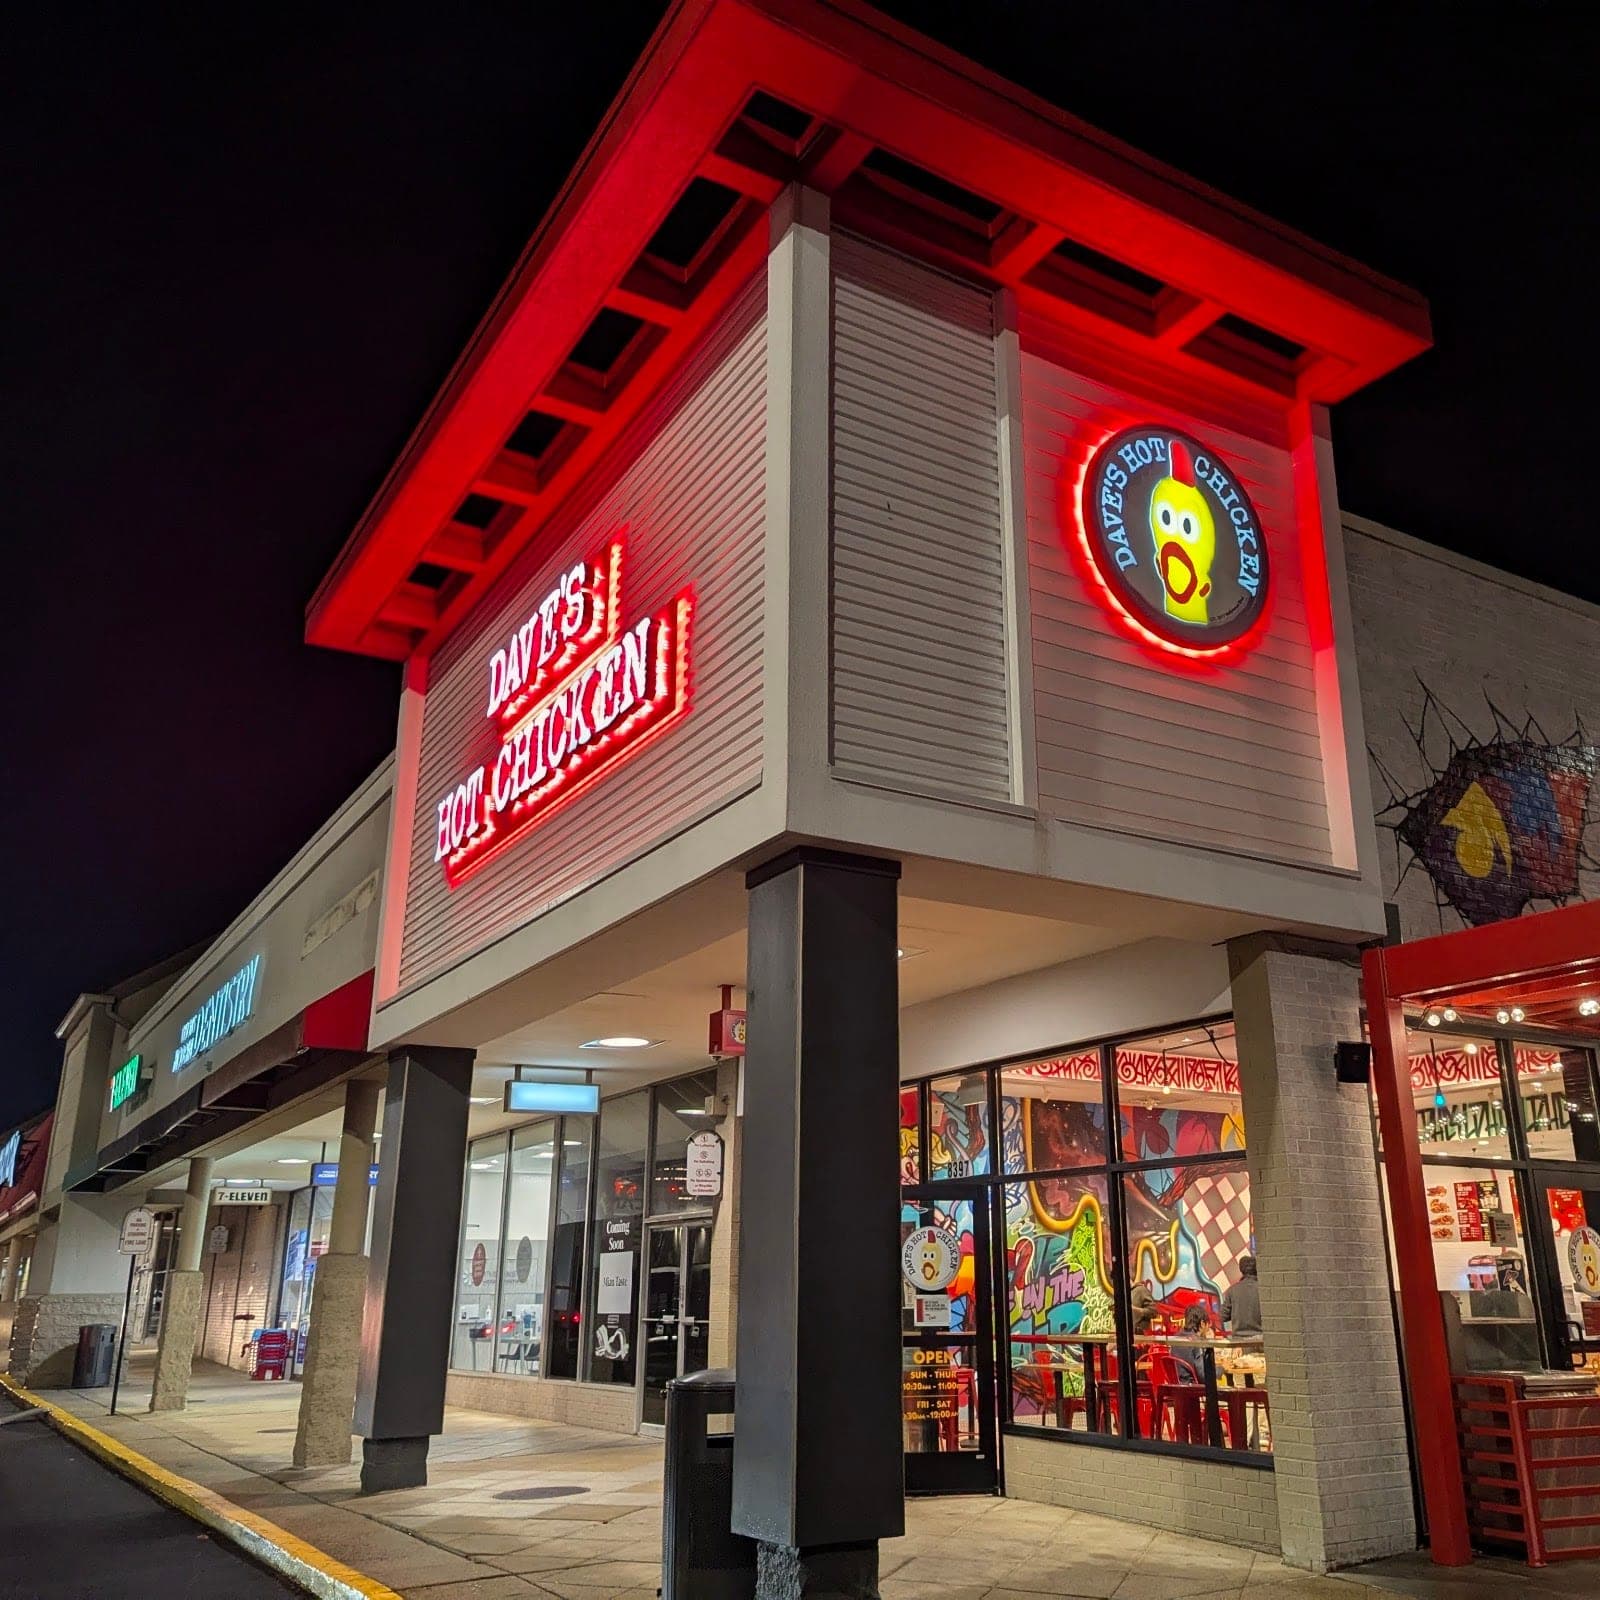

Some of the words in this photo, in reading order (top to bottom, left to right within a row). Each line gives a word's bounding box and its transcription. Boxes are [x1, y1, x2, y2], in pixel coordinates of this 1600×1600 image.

[1117, 437, 1166, 473] HOT
[1101, 463, 1137, 571] DAVE'S
[1194, 456, 1260, 597] CHICKEN
[487, 562, 585, 717] DAVE'S
[434, 766, 485, 862] HOT
[491, 617, 651, 812] CHICKEN
[947, 1161, 969, 1178] 8397
[606, 1220, 631, 1236] Coming
[609, 1237, 624, 1251] Soon
[904, 1244, 916, 1276] DAVE'S
[910, 1231, 927, 1246] HOT
[936, 1231, 958, 1270] CHICKEN
[1050, 1267, 1084, 1306] THE
[910, 1371, 927, 1379] SUN
[935, 1371, 957, 1379] THUR
[913, 1351, 954, 1364] OPEN
[916, 1400, 930, 1409] FRI
[936, 1400, 952, 1409] SAT
